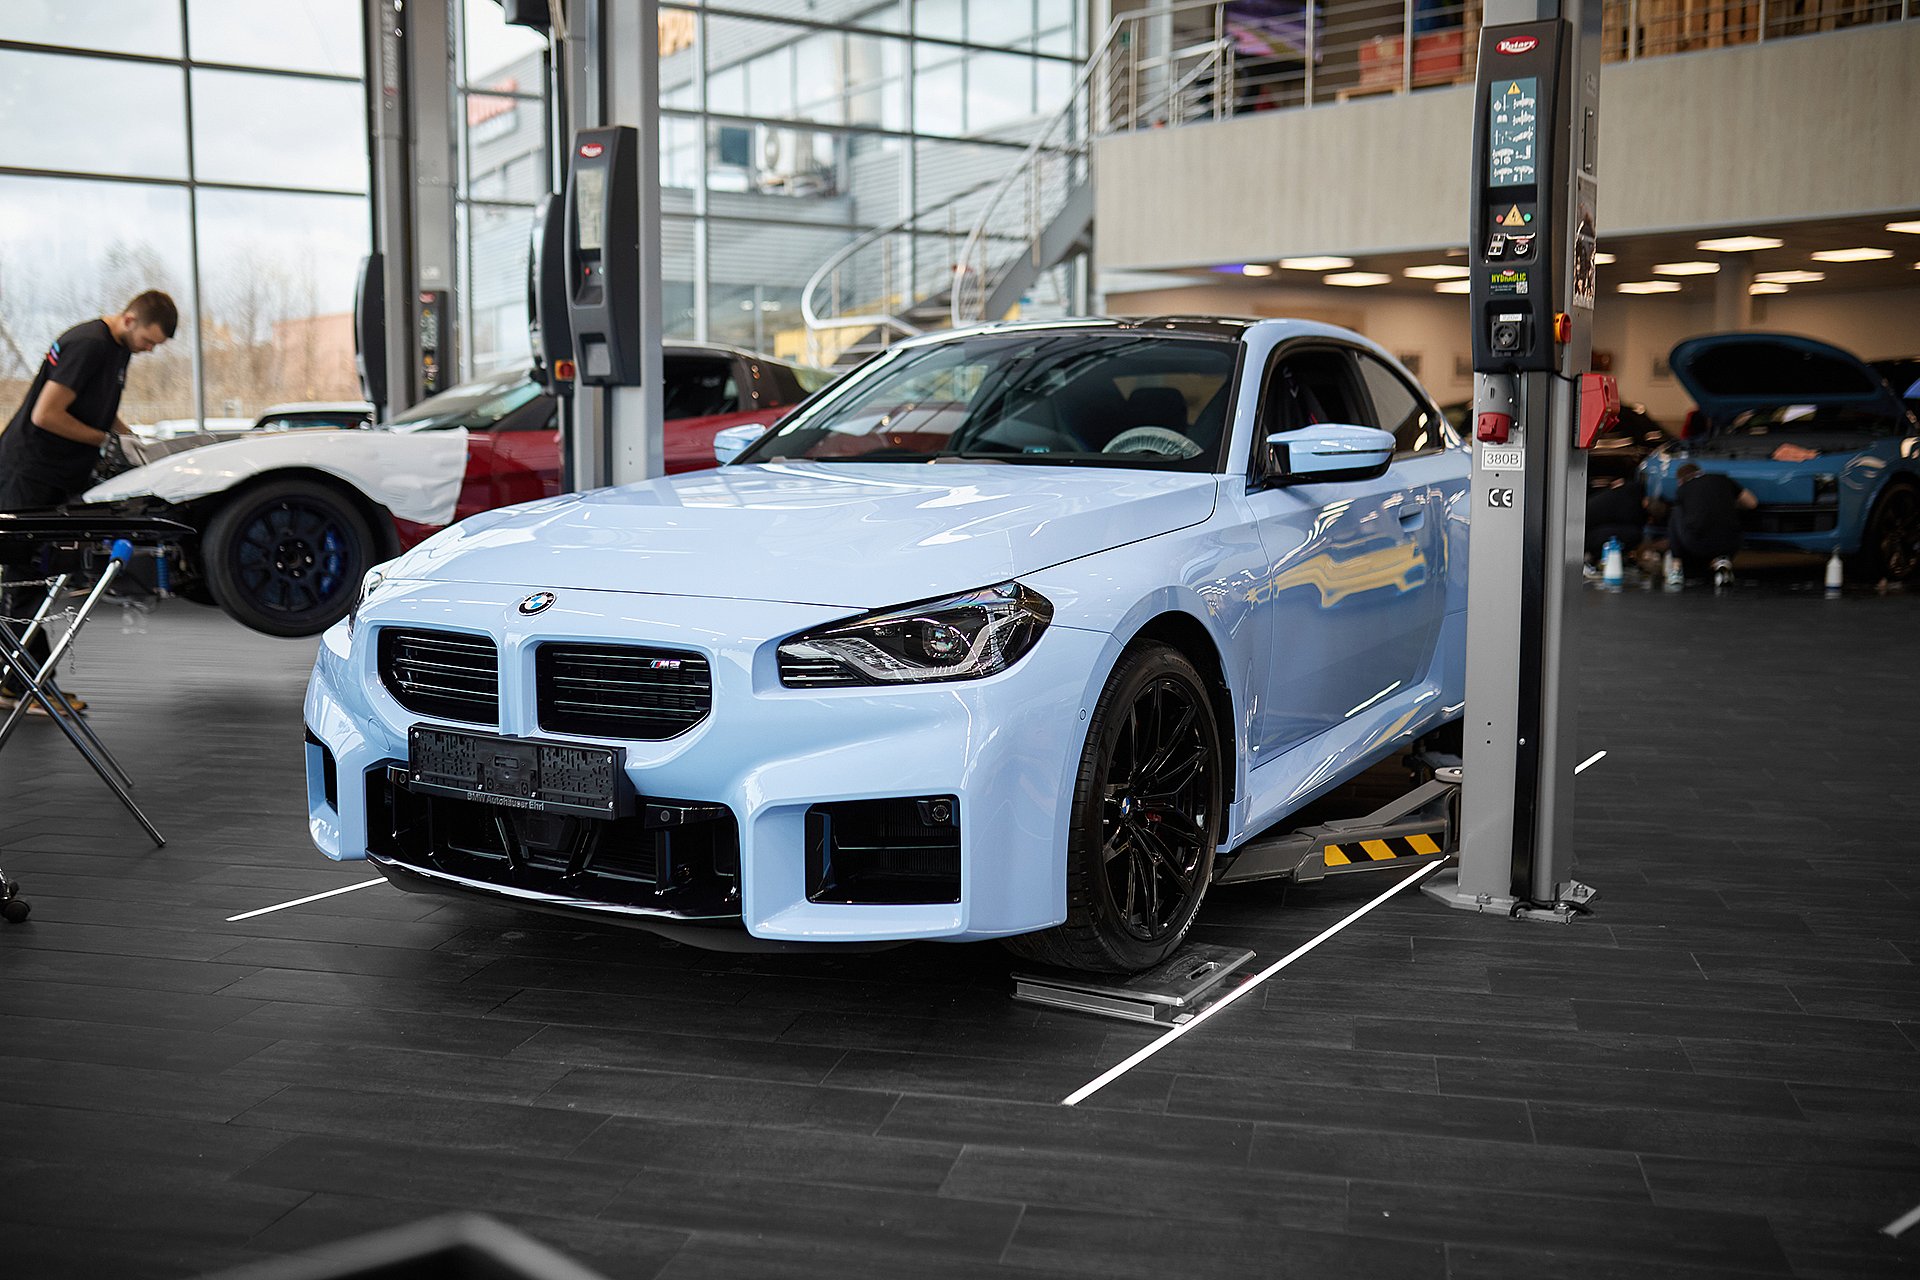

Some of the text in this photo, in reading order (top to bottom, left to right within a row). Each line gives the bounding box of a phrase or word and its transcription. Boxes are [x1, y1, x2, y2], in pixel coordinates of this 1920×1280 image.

[1500, 40, 1536, 52] Rotary
[1491, 272, 1527, 284] HYDRAULIC
[1487, 453, 1519, 465] 380B
[466, 792, 486, 802] BMW
